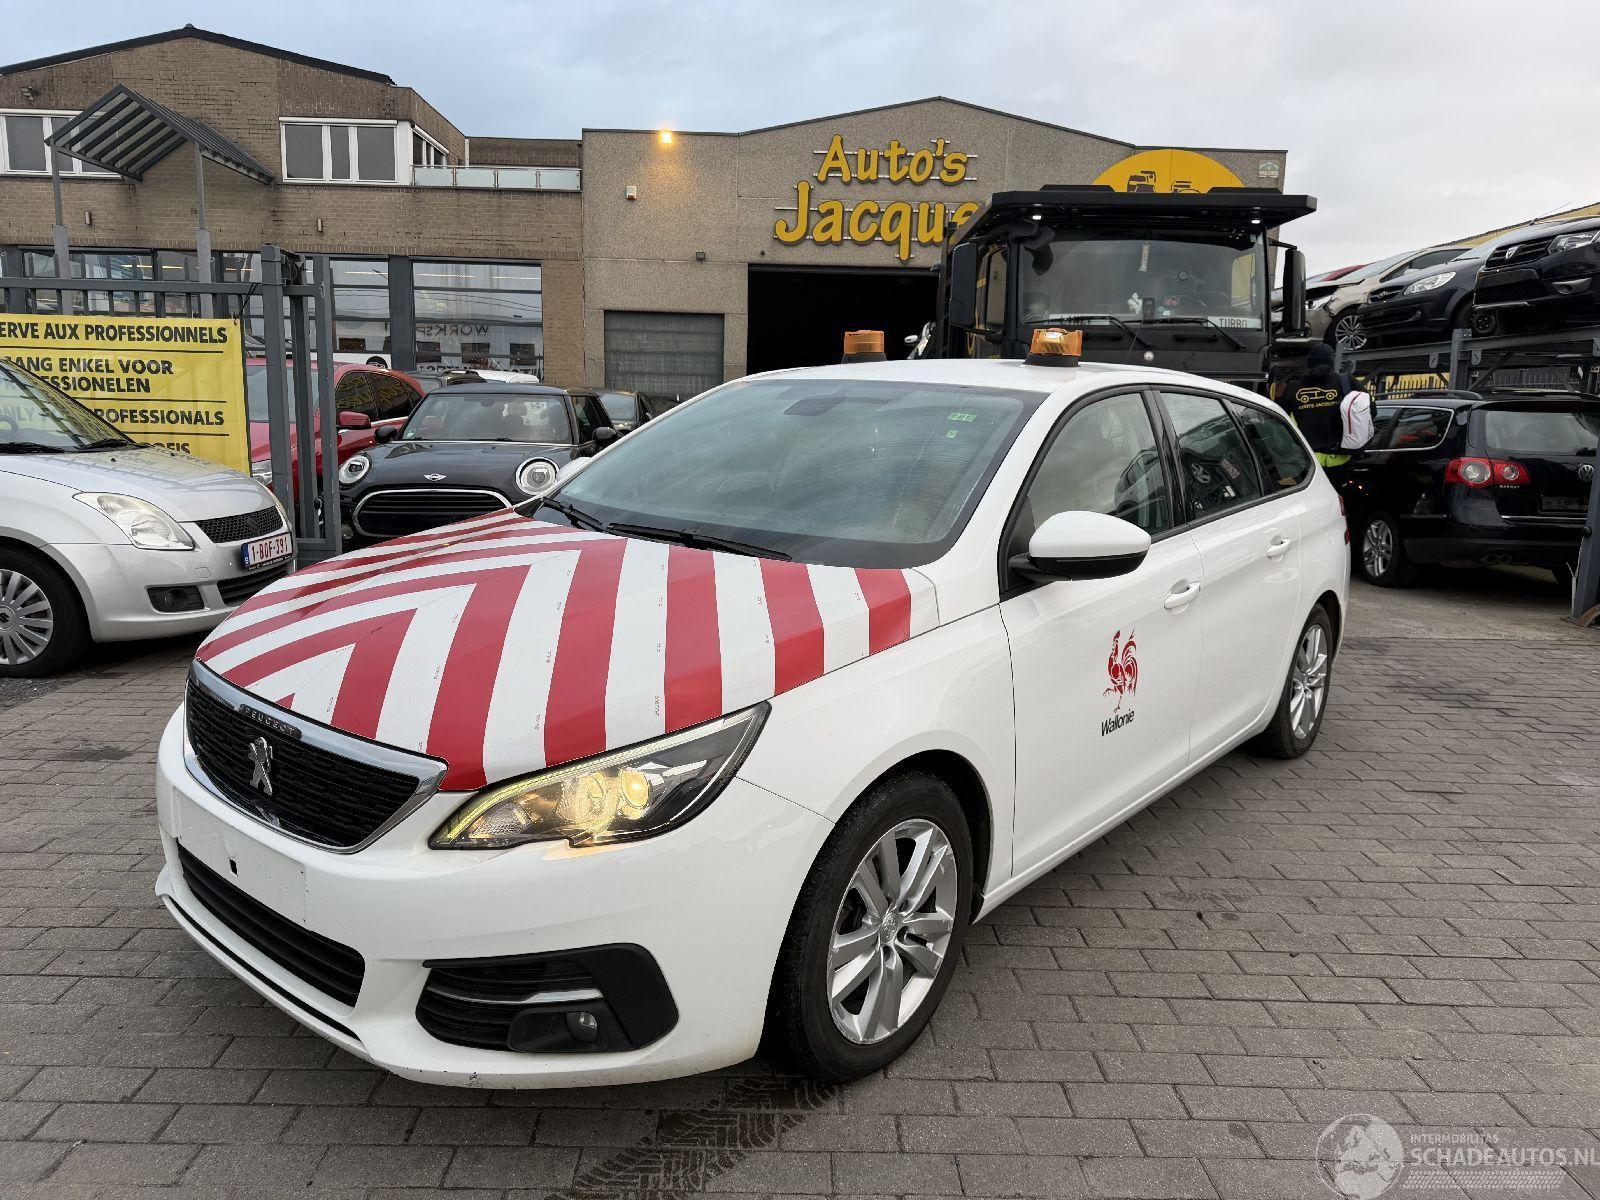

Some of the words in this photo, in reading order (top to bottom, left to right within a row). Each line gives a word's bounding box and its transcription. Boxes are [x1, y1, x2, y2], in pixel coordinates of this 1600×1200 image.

[817, 134, 968, 186] Auto's
[44, 323, 80, 340] AUX
[84, 324, 228, 343] PROFESSIONNELS
[58, 357, 115, 373] ENKEL
[118, 359, 174, 375] VOOR
[244, 706, 296, 736] PEUGEOT
[1101, 709, 1135, 737] Wallonie
